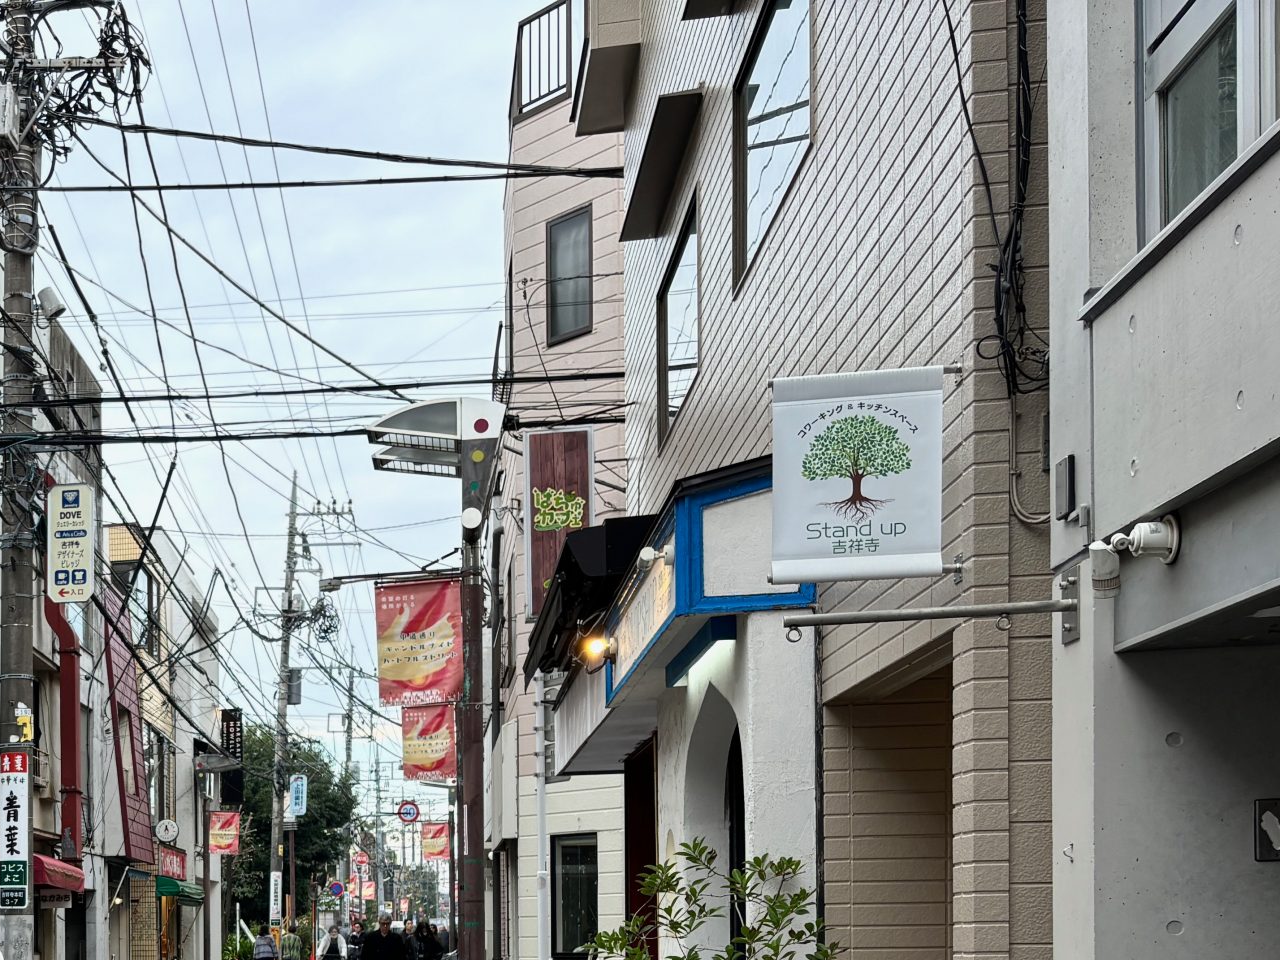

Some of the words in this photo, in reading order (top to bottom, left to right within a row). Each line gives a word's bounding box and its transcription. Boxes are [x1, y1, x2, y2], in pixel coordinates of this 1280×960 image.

[797, 404, 843, 438] コワーキング
[857, 402, 919, 434] キッチンスペース
[60, 511, 82, 520] DOVE
[806, 519, 872, 540] Stand
[880, 522, 907, 537] up
[61, 541, 80, 549] 吉祥寺
[831, 538, 880, 555] 吉祥寺
[57, 550, 84, 559] デザイナーズ
[1, 754, 23, 772] 青葉
[403, 807, 415, 818] 30
[3, 790, 21, 856] 青葉
[1, 863, 24, 872] コピス
[3, 873, 20, 883] よこ
[5, 898, 19, 906] 3-7
